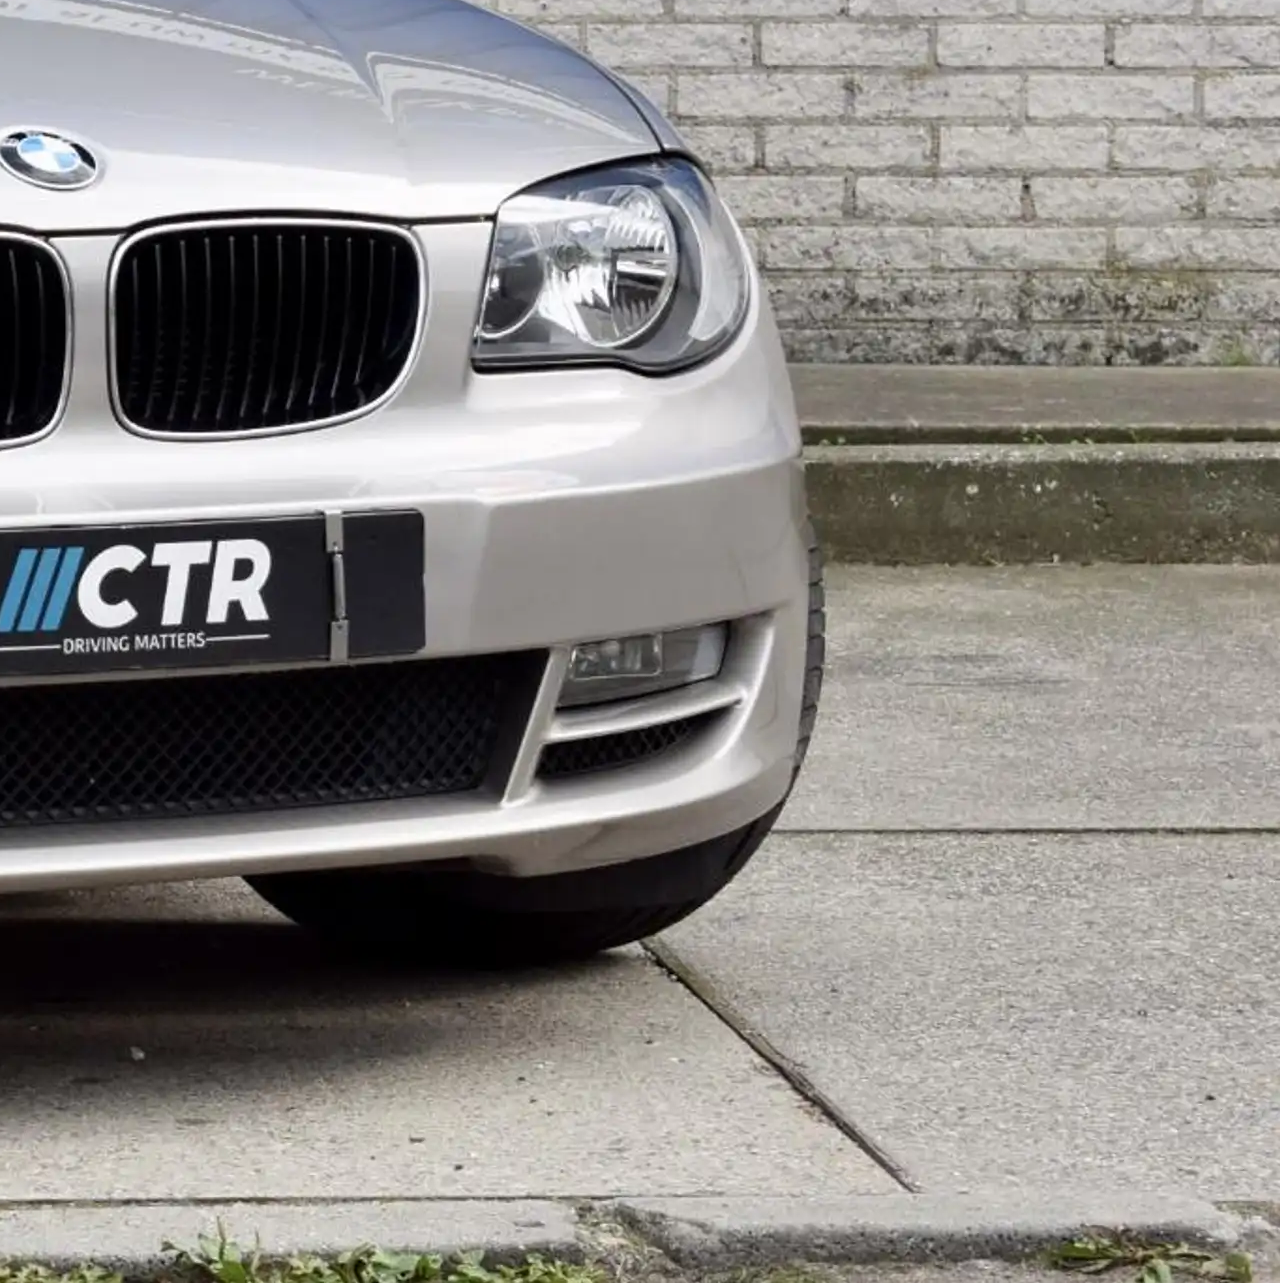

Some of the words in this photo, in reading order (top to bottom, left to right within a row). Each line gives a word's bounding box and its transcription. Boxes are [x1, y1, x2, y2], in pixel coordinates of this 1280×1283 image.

[77, 537, 272, 629] CTR
[63, 633, 130, 656] DRIVING
[133, 631, 207, 653] MATTERS
